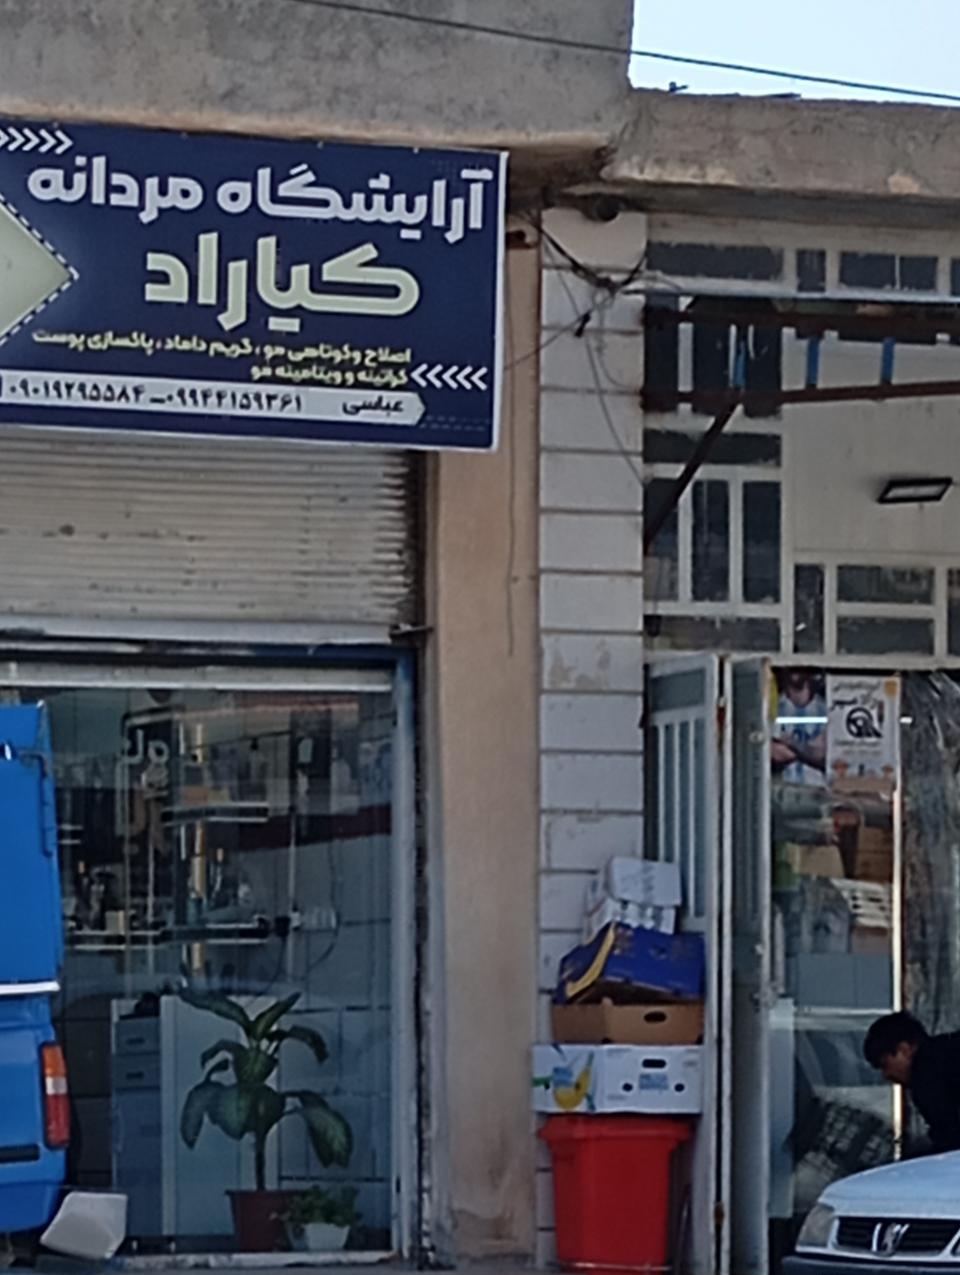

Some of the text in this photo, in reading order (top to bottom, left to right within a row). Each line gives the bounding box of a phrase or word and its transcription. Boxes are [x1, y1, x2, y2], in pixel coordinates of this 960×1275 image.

[28, 156, 493, 244] آرایشگاه مردانه
[145, 232, 420, 332] کیاراد
[32, 329, 85, 352] پوست
[87, 331, 154, 356] پاکسازی
[364, 346, 412, 367] اصلاح
[250, 364, 273, 381] مو
[342, 395, 404, 417] عباسی
